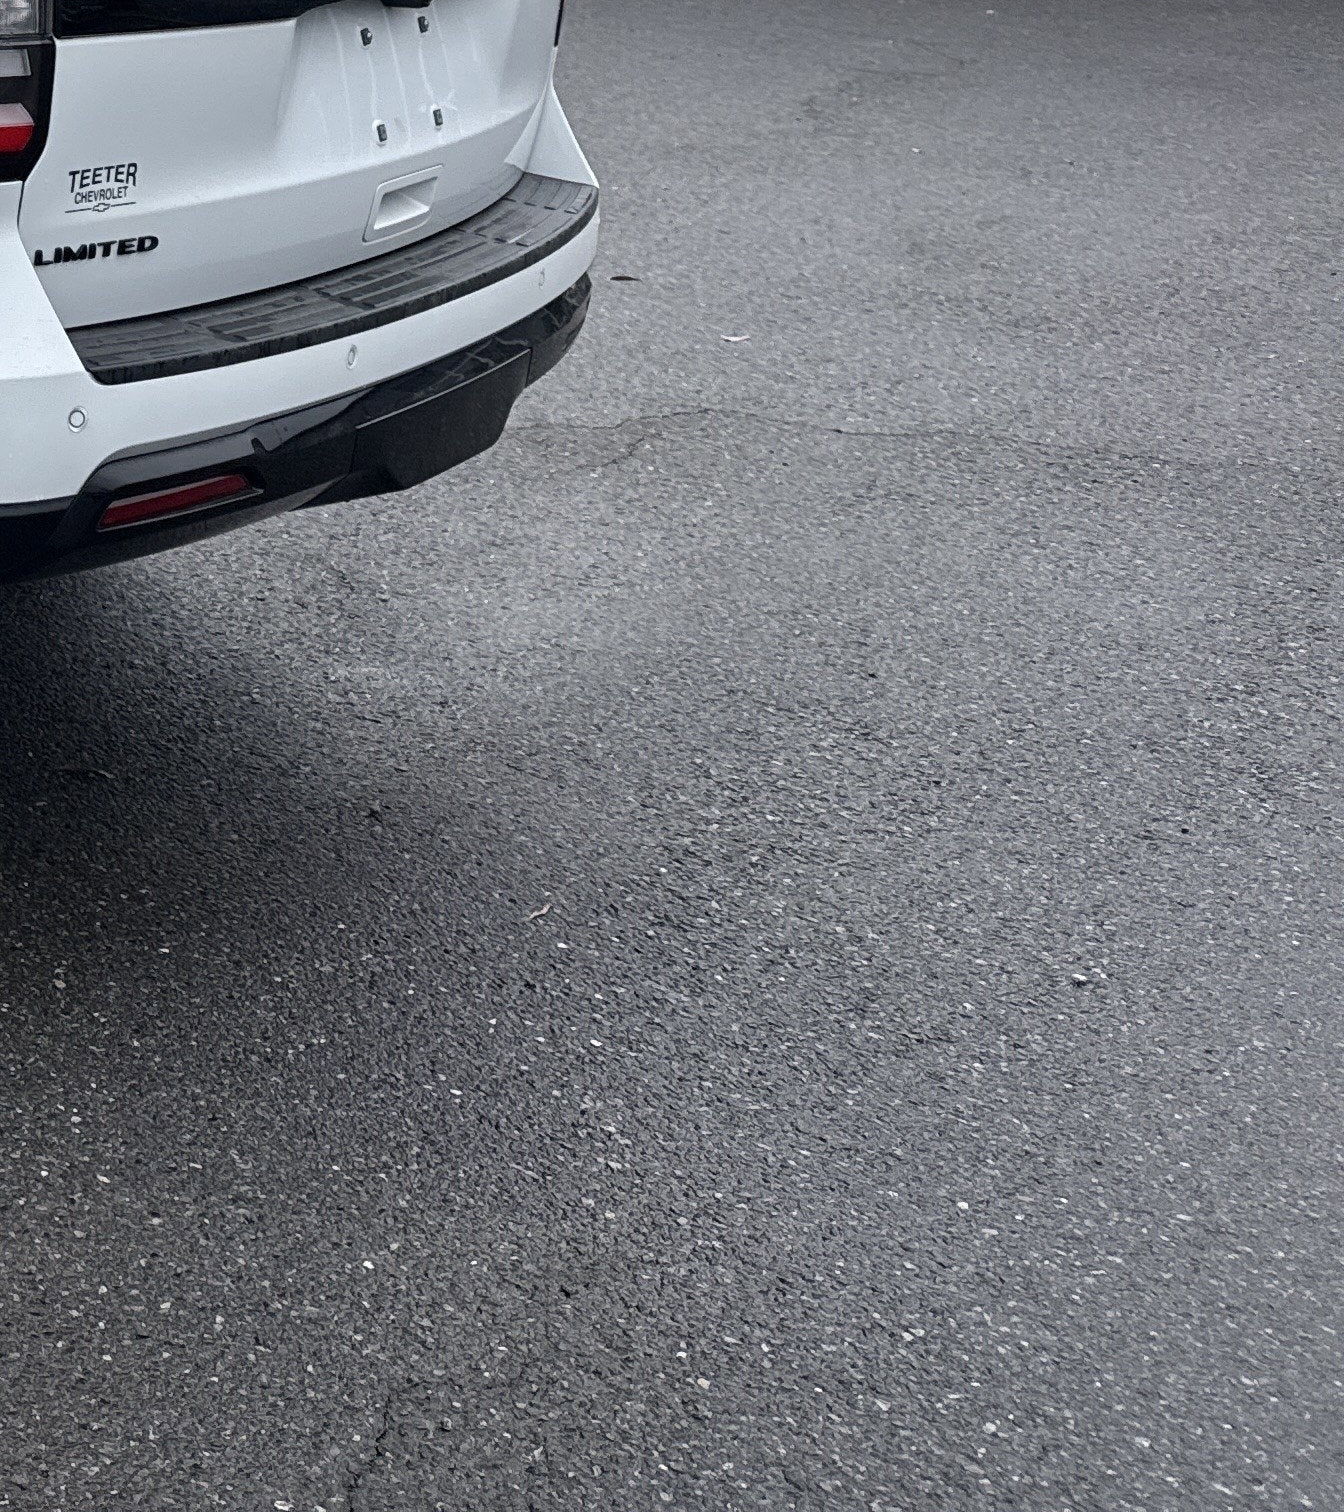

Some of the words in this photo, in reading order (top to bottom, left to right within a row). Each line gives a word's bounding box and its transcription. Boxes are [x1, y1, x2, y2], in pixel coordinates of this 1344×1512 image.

[68, 162, 138, 193] TEETER
[74, 186, 128, 204] CHEVROLET
[33, 235, 159, 266] LIMITED
